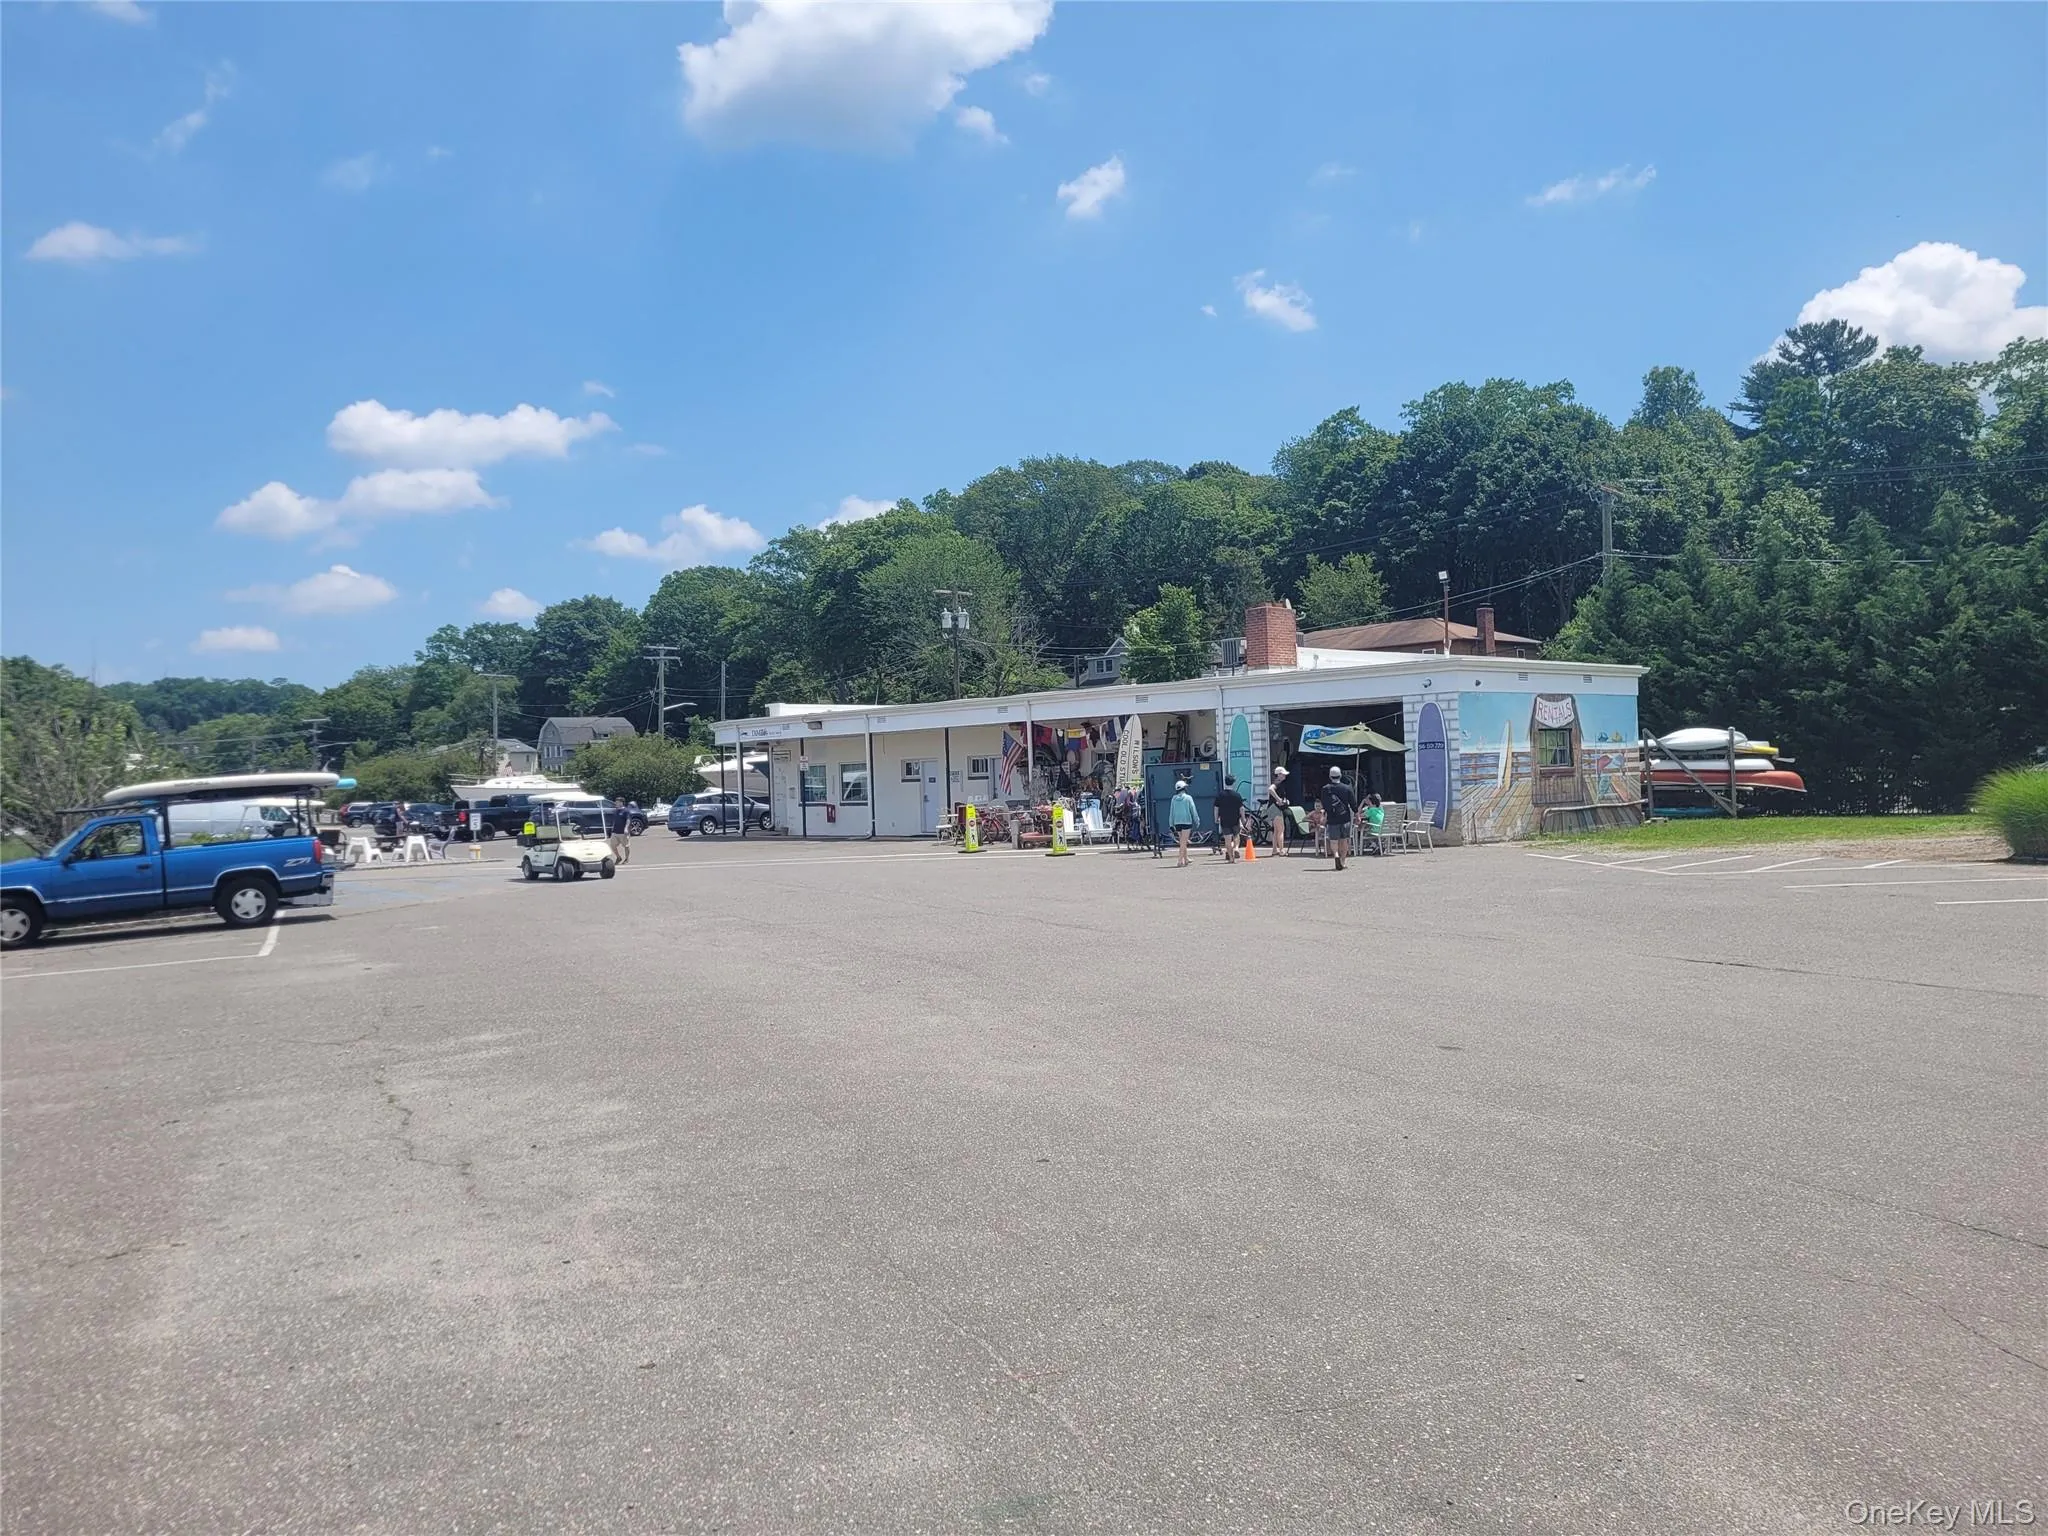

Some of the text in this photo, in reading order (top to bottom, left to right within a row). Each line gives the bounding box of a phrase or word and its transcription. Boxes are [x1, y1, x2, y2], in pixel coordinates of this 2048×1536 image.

[1537, 701, 1572, 724] RENTALS
[1122, 729, 1130, 749] COOL
[283, 857, 312, 867] Z71
